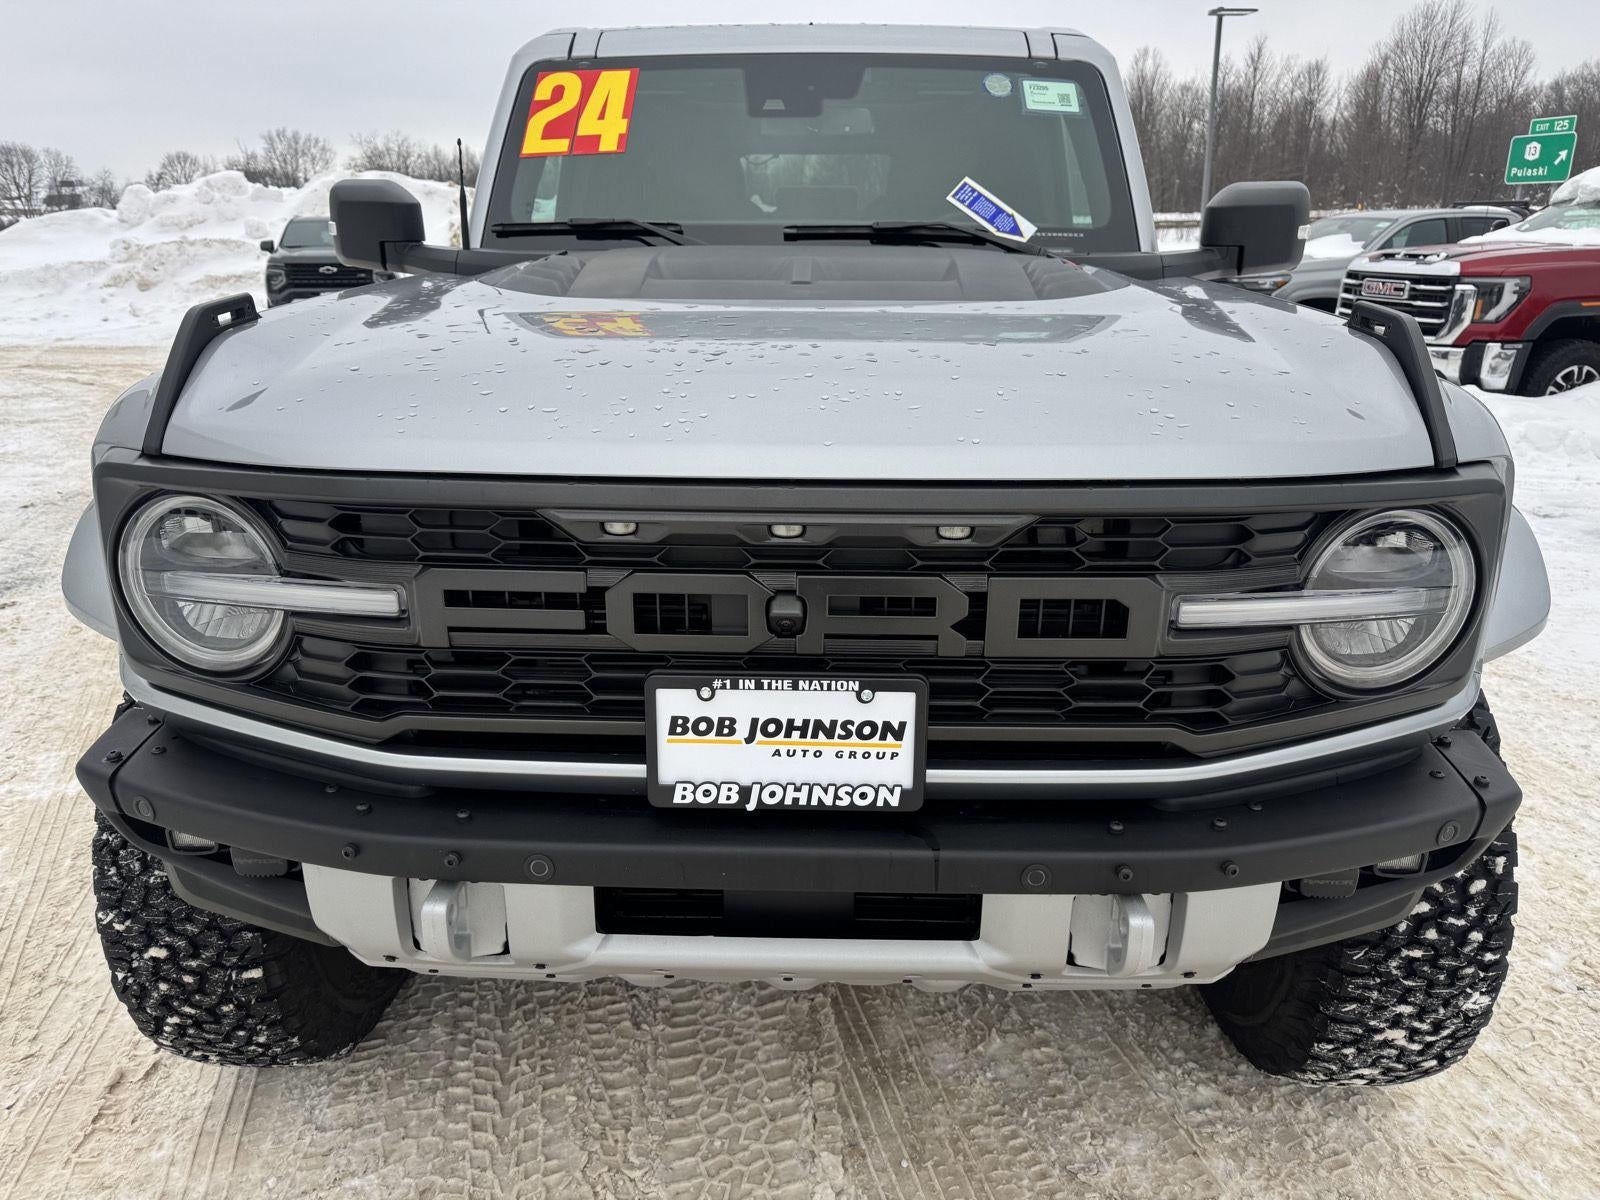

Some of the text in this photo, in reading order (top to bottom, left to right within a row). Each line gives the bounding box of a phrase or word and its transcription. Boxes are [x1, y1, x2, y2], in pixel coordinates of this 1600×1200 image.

[522, 70, 631, 154] 24
[1536, 120, 1569, 131] EXIT 125
[1527, 146, 1537, 156] 13
[1511, 166, 1547, 176] Pulaski
[1365, 281, 1405, 296] GMC
[414, 567, 1164, 657] FORD
[712, 678, 859, 691] #1 IN THE NATION
[668, 715, 907, 744] BOB JOHNSON
[772, 749, 899, 760] AUTO GROUP
[673, 783, 900, 811] BOB JOHNSON
